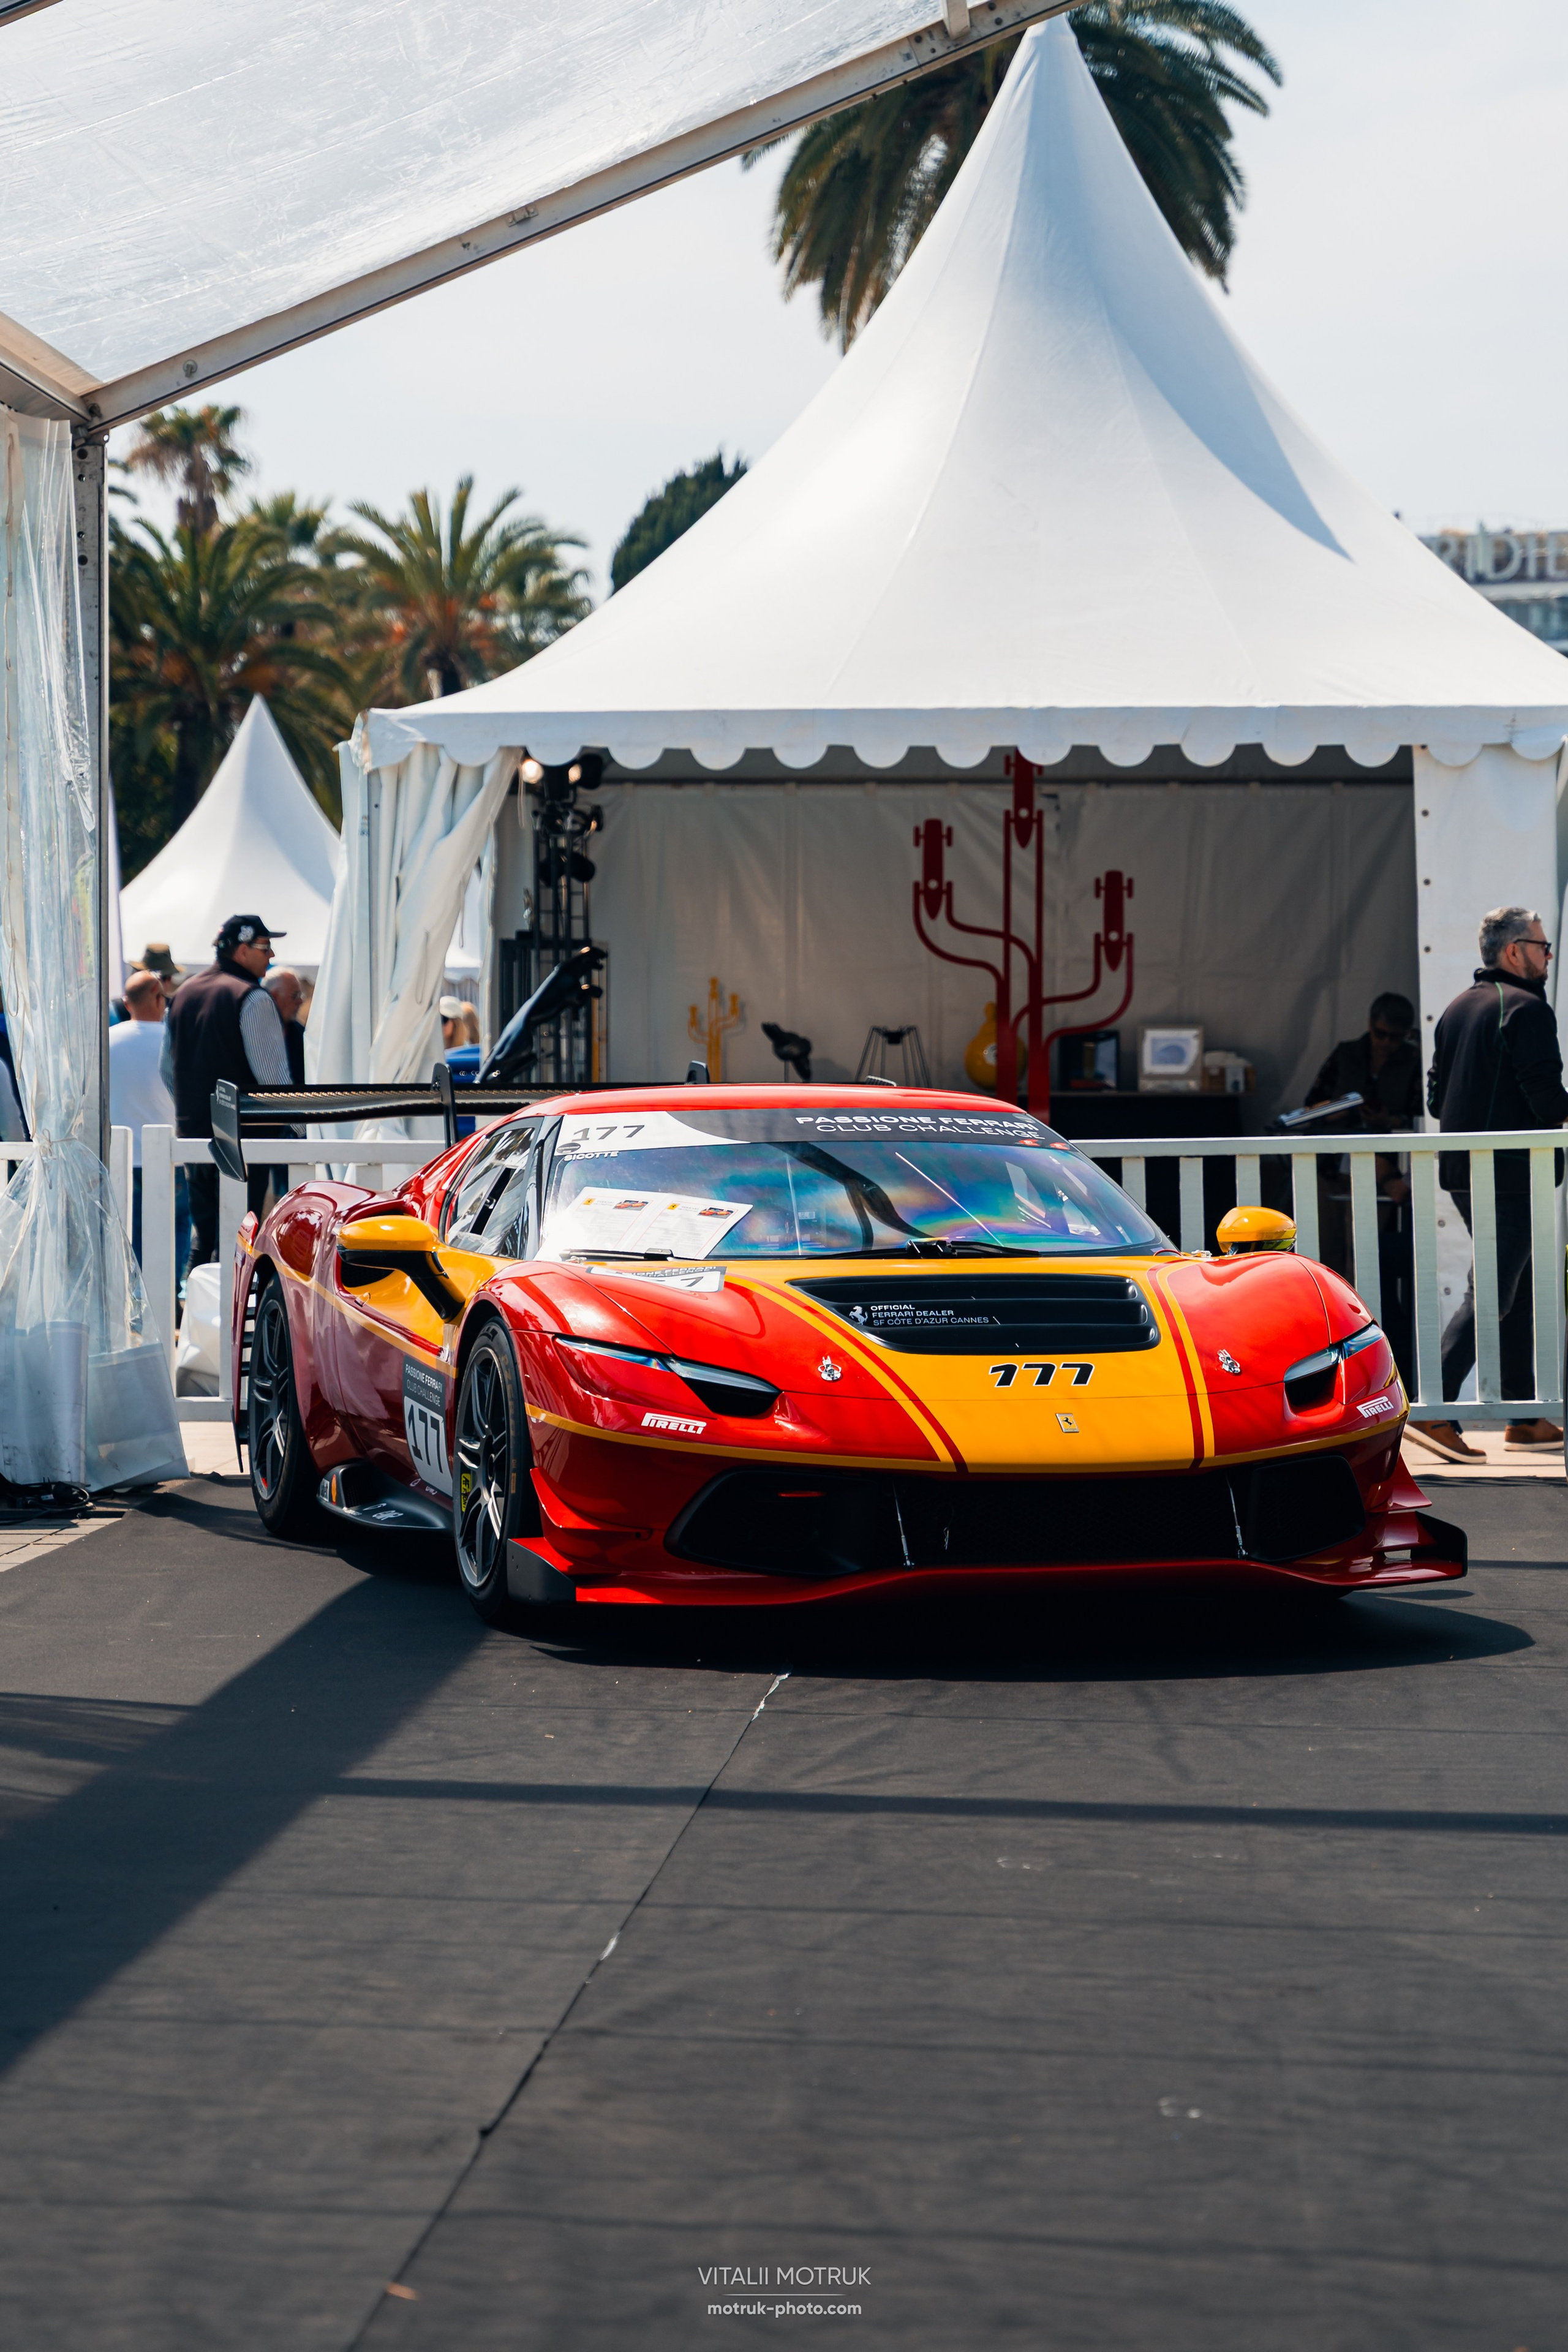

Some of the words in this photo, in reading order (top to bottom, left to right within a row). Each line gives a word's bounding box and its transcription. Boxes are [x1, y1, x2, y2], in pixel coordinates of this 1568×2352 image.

[571, 1125, 645, 1142] 177
[795, 1116, 937, 1125] PASSIONE
[938, 1117, 1039, 1131] FERRARI
[899, 1124, 1046, 1140] CHALLENGE
[564, 1151, 619, 1161] SICOTTE
[405, 1363, 425, 1383] PASSIONE
[424, 1374, 442, 1393] FERRARI
[988, 1362, 1095, 1388] 177
[406, 1379, 417, 1393] CLUB
[417, 1385, 440, 1407] CHALLENGE
[1355, 1395, 1395, 1419] PIRELLI
[641, 1412, 707, 1434] PIRELLI
[408, 1404, 443, 1474] 177
